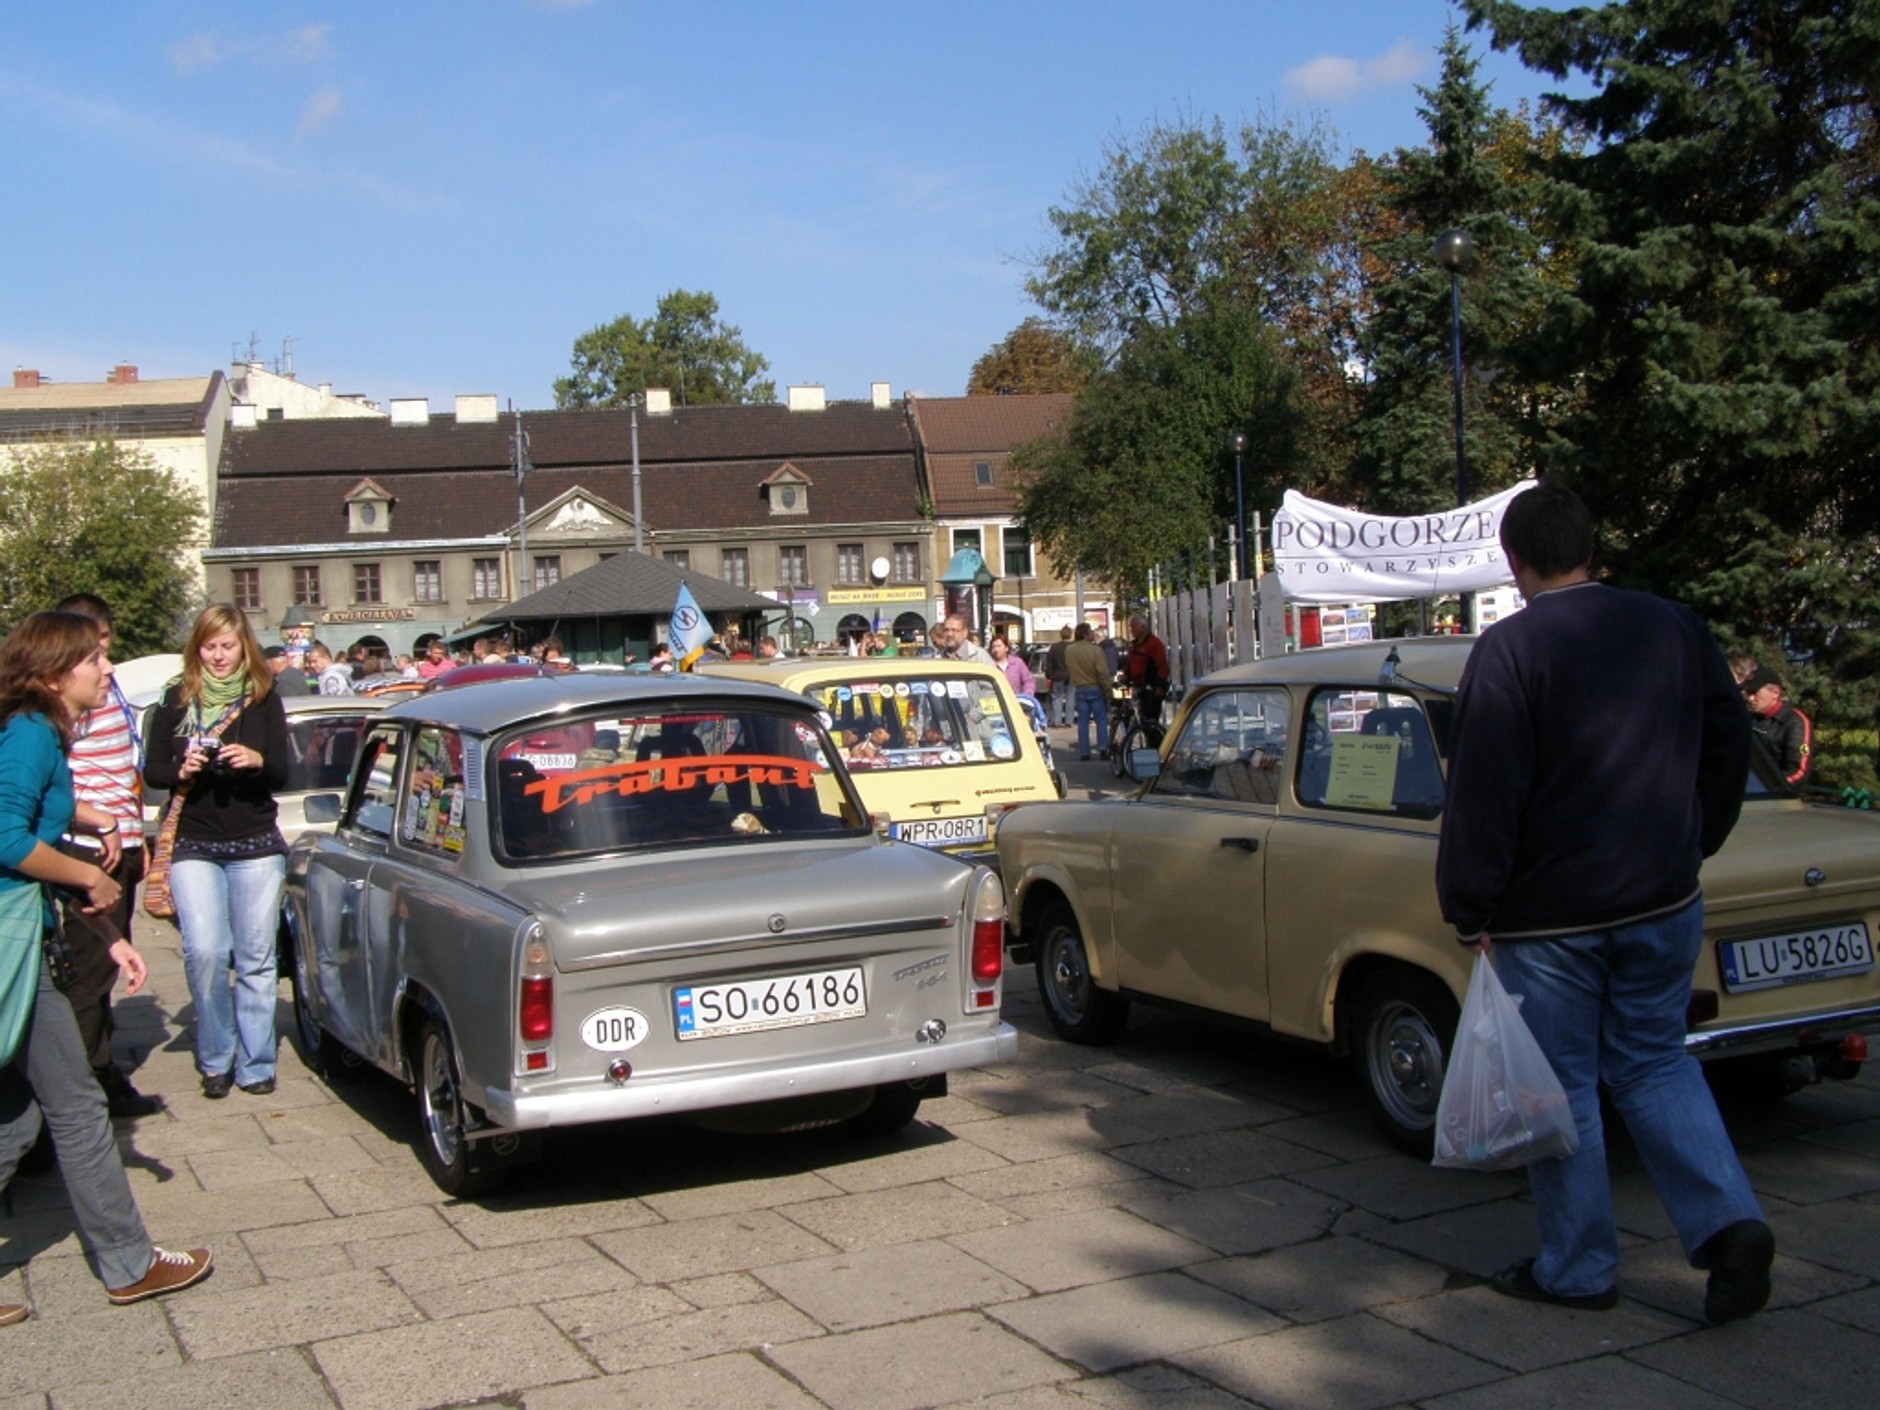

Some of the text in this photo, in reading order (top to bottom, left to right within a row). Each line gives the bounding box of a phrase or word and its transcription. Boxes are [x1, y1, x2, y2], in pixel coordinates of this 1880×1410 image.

[1275, 510, 1496, 550] PODGORZE
[1276, 550, 1497, 576] STOWARZYSZE
[525, 755, 822, 813] Trabant
[901, 822, 938, 842] WPR
[943, 818, 984, 838] 08R1
[1740, 928, 1863, 978] LU 5826G
[699, 987, 748, 1023] SO
[762, 972, 859, 1016] 66186
[596, 1016, 636, 1044] DDR
